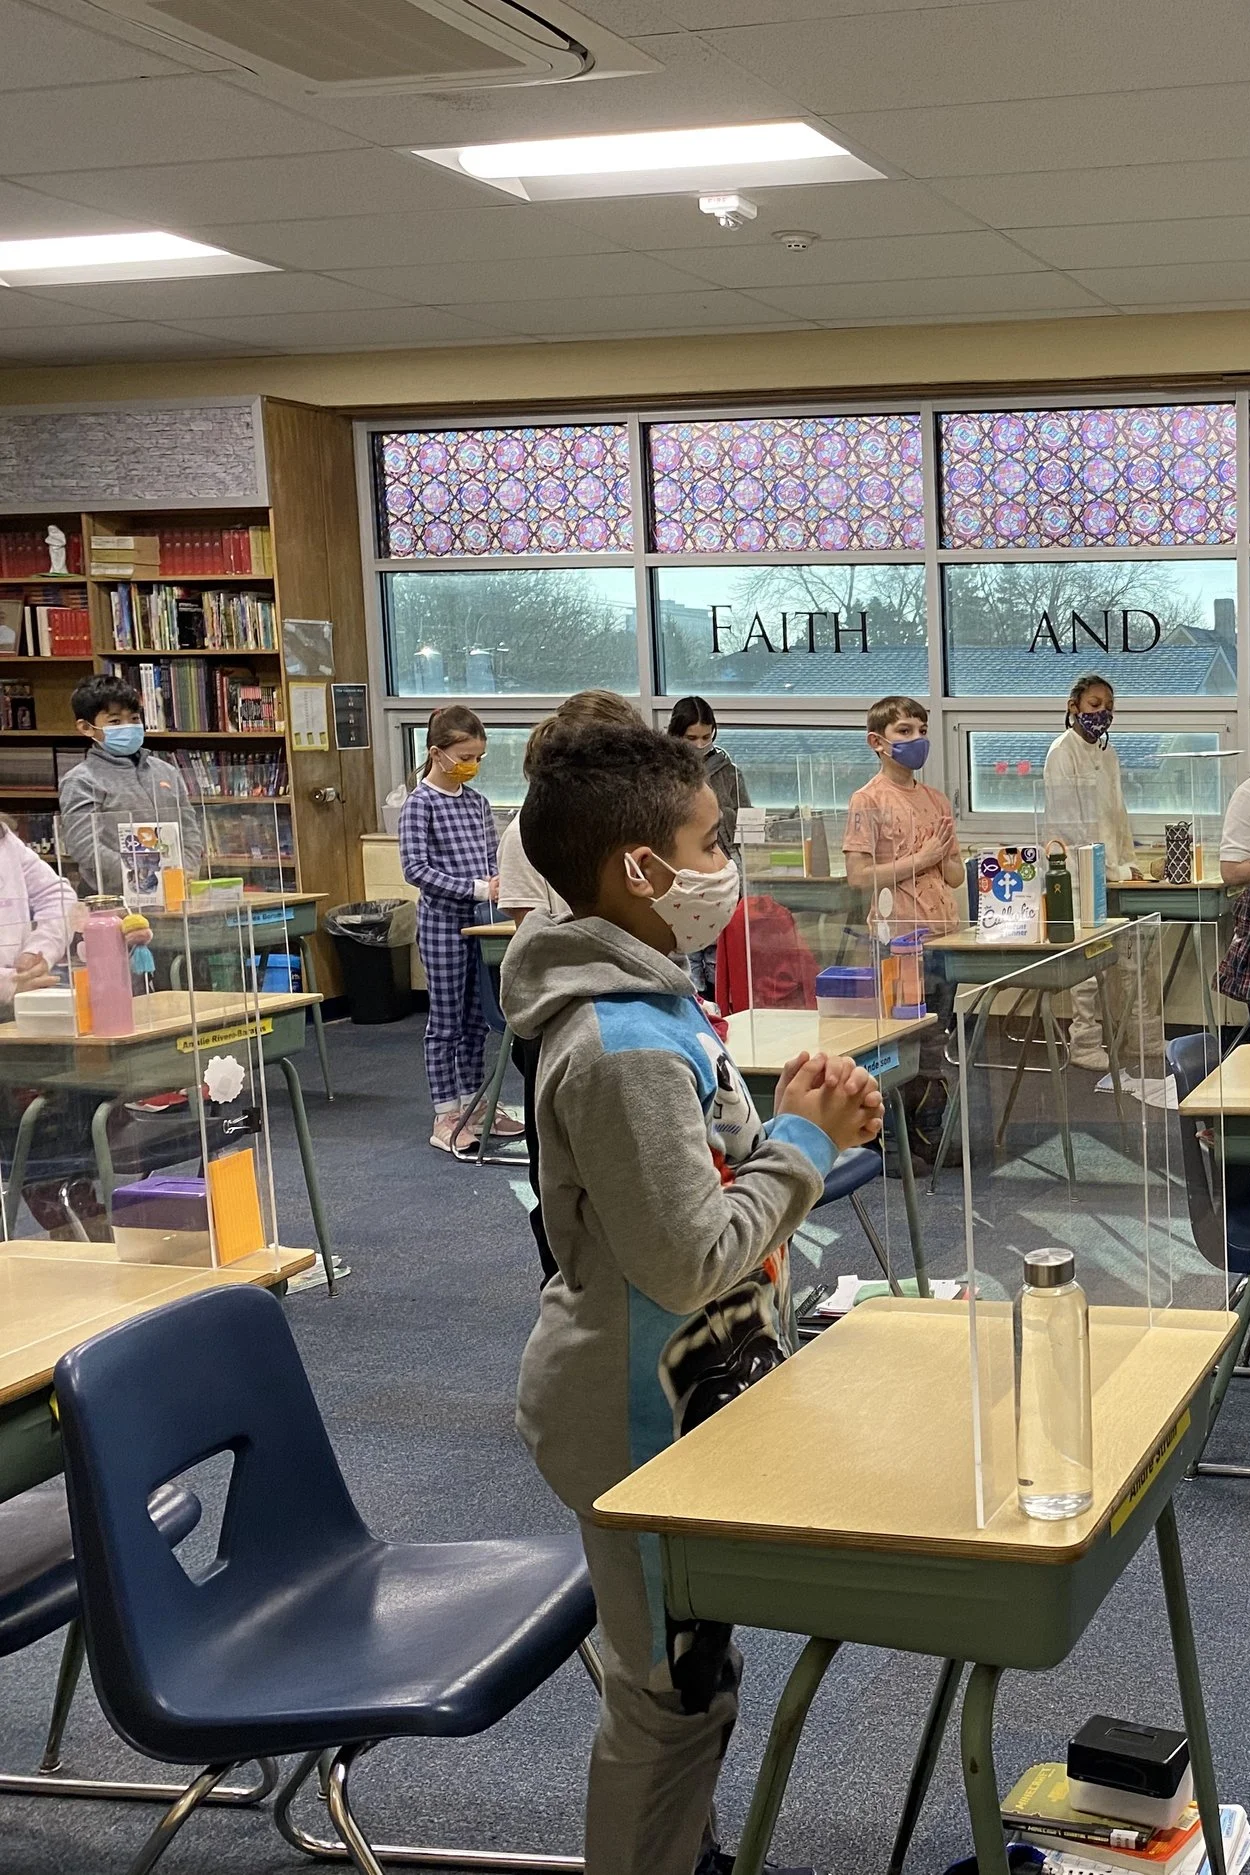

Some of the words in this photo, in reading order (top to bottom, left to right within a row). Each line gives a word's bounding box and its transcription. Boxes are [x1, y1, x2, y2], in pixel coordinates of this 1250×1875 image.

[708, 604, 873, 653] FAITH
[1027, 609, 1162, 654] AND
[863, 1056, 892, 1072] Andeson
